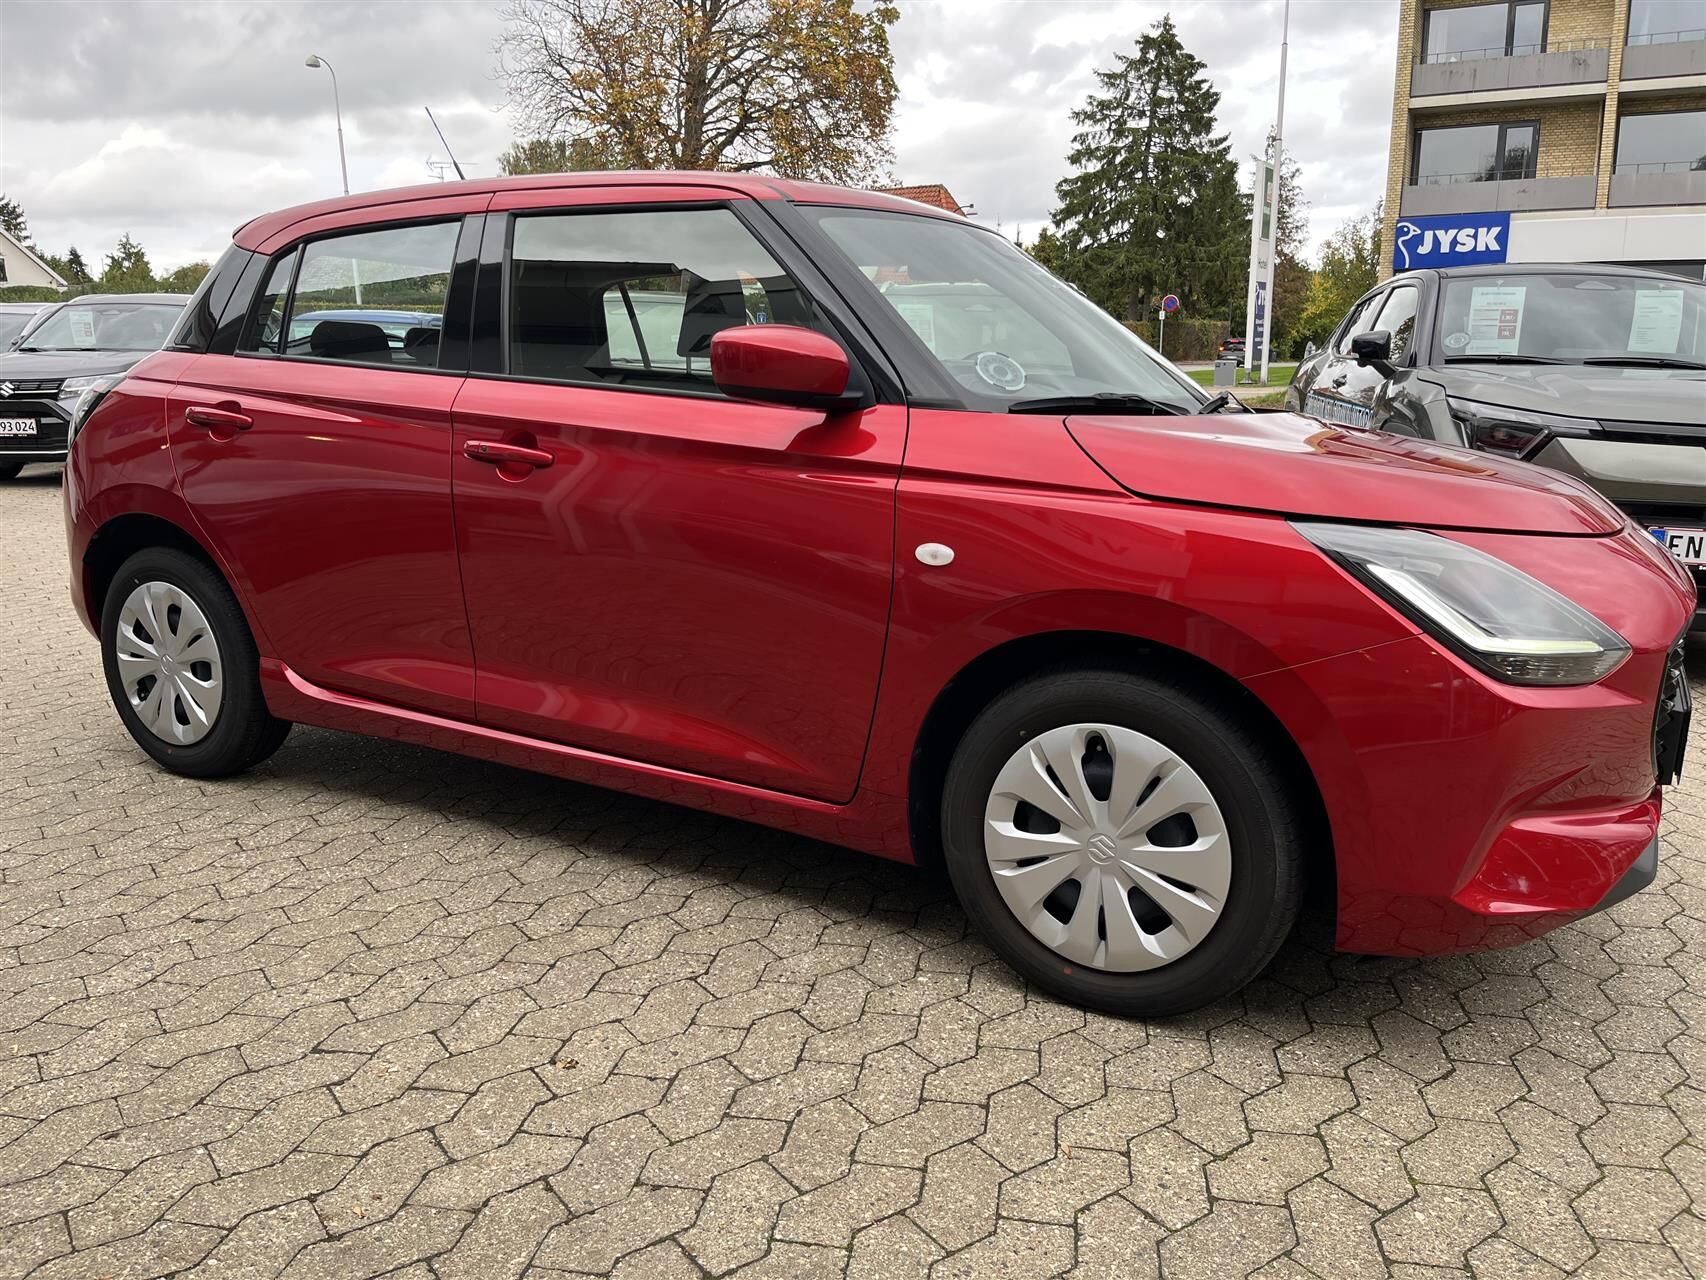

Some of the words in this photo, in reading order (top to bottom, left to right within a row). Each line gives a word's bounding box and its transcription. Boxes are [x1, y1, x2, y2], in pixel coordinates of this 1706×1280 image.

[1416, 226, 1503, 255] JYSK
[0, 421, 13, 432] 93
[15, 421, 35, 432] 024
[1668, 534, 1704, 559] EN
